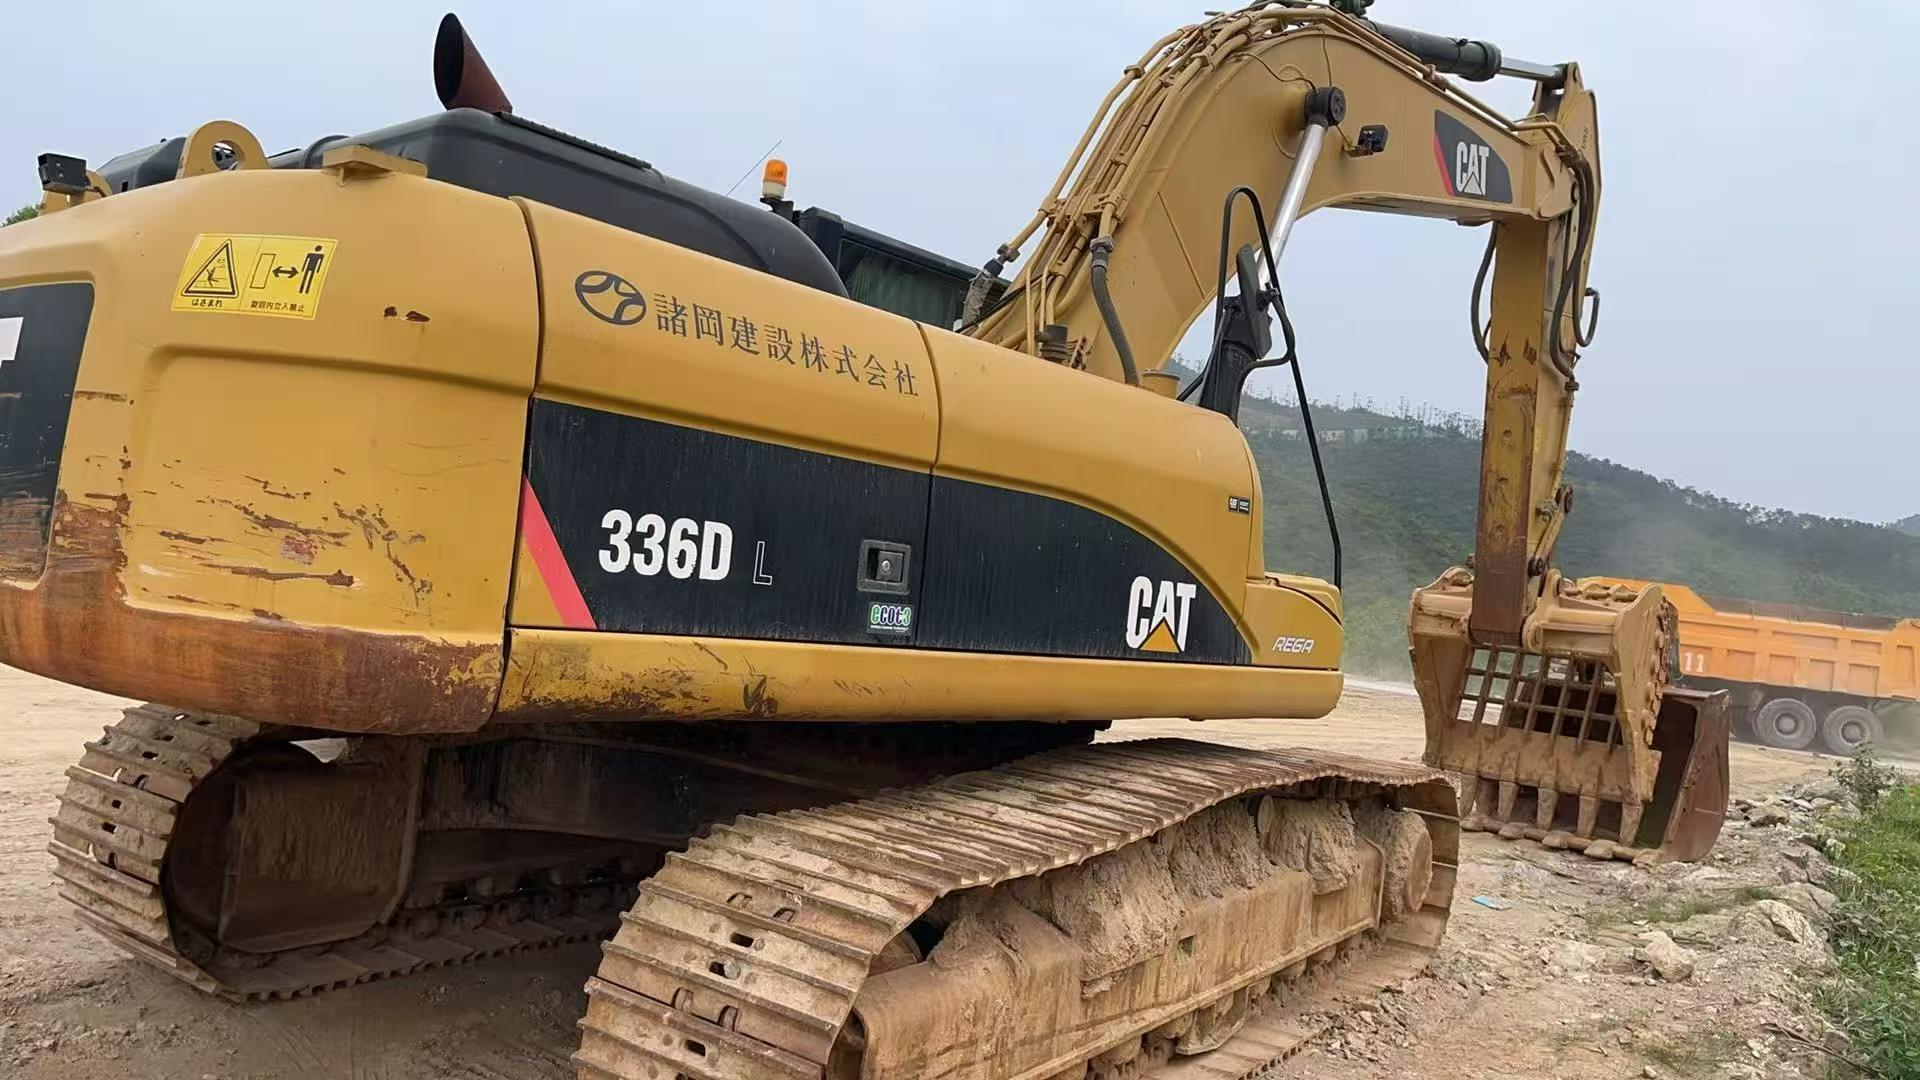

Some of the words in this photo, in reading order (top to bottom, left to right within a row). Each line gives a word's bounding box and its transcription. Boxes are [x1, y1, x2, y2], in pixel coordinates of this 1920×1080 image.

[1456, 142, 1489, 195] CAT
[191, 298, 223, 307] はさまれ
[653, 292, 919, 397] 諸岡建設株式会社
[598, 509, 733, 581] 336D
[753, 541, 773, 585] L
[1126, 576, 1196, 652] CAT
